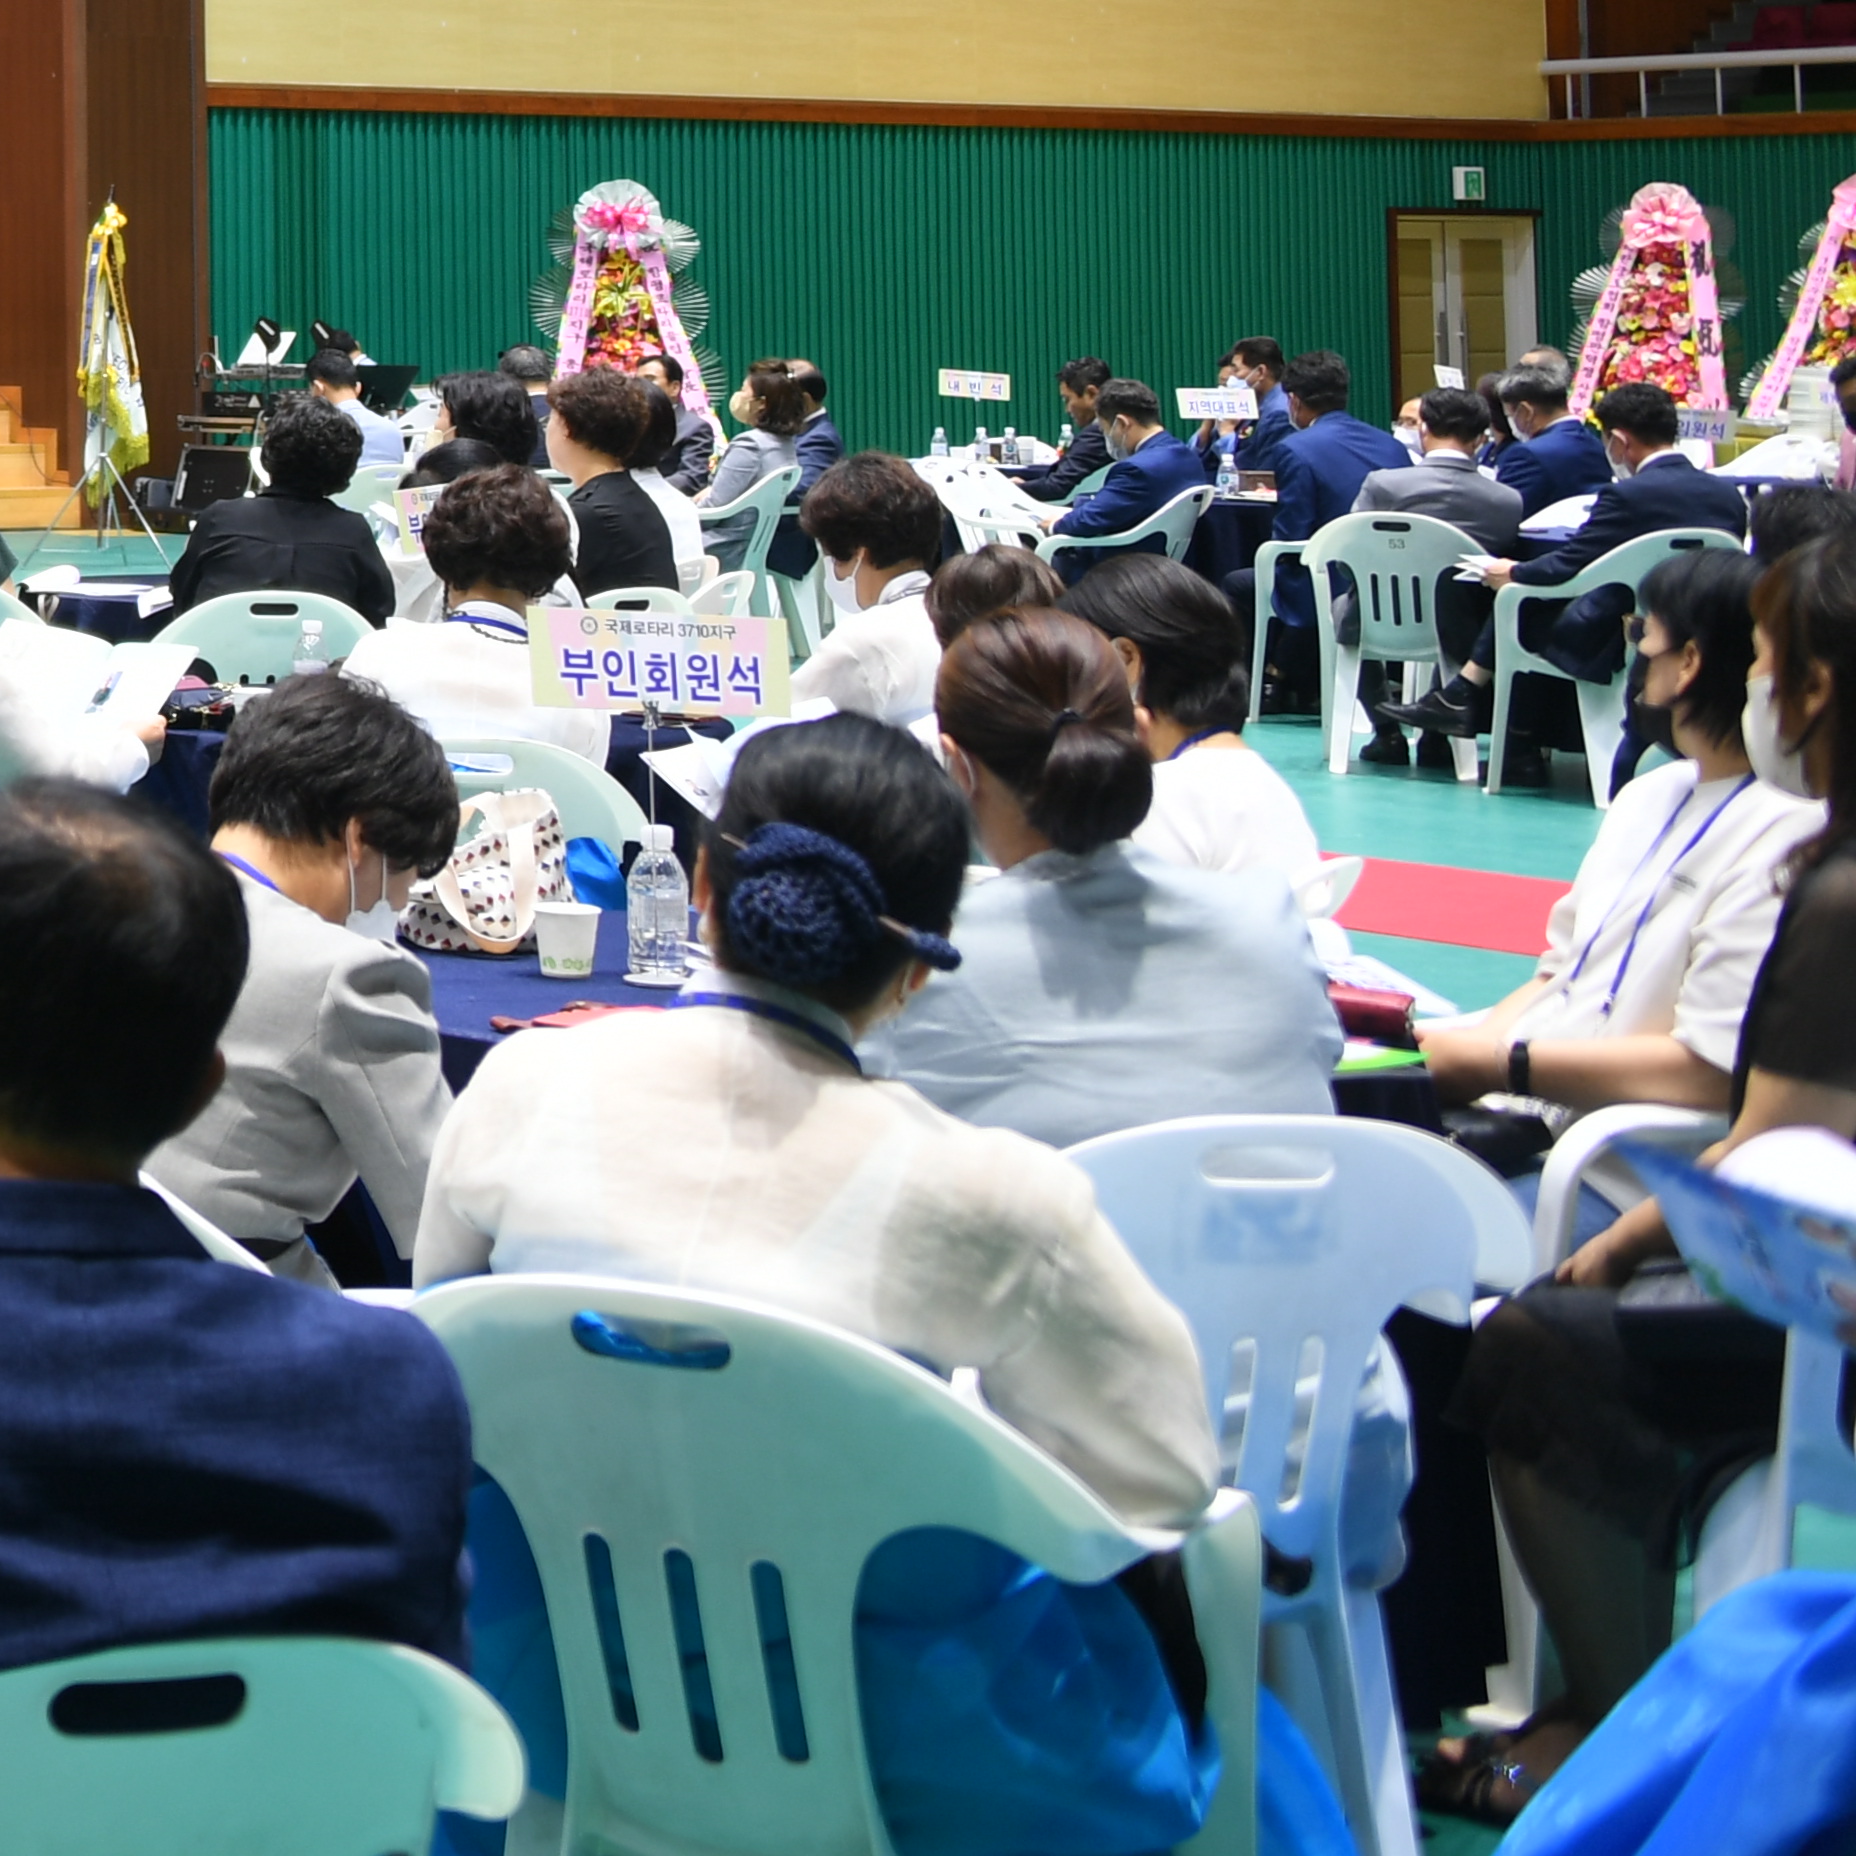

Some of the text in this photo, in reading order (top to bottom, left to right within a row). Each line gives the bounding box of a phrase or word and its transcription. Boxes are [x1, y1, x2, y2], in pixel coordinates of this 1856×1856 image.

[1188, 400, 1250, 414] 지역대표석
[1388, 538, 1406, 549] 53
[604, 618, 736, 640] 국제로타리 3710지구
[560, 647, 762, 705] 부인회원석
